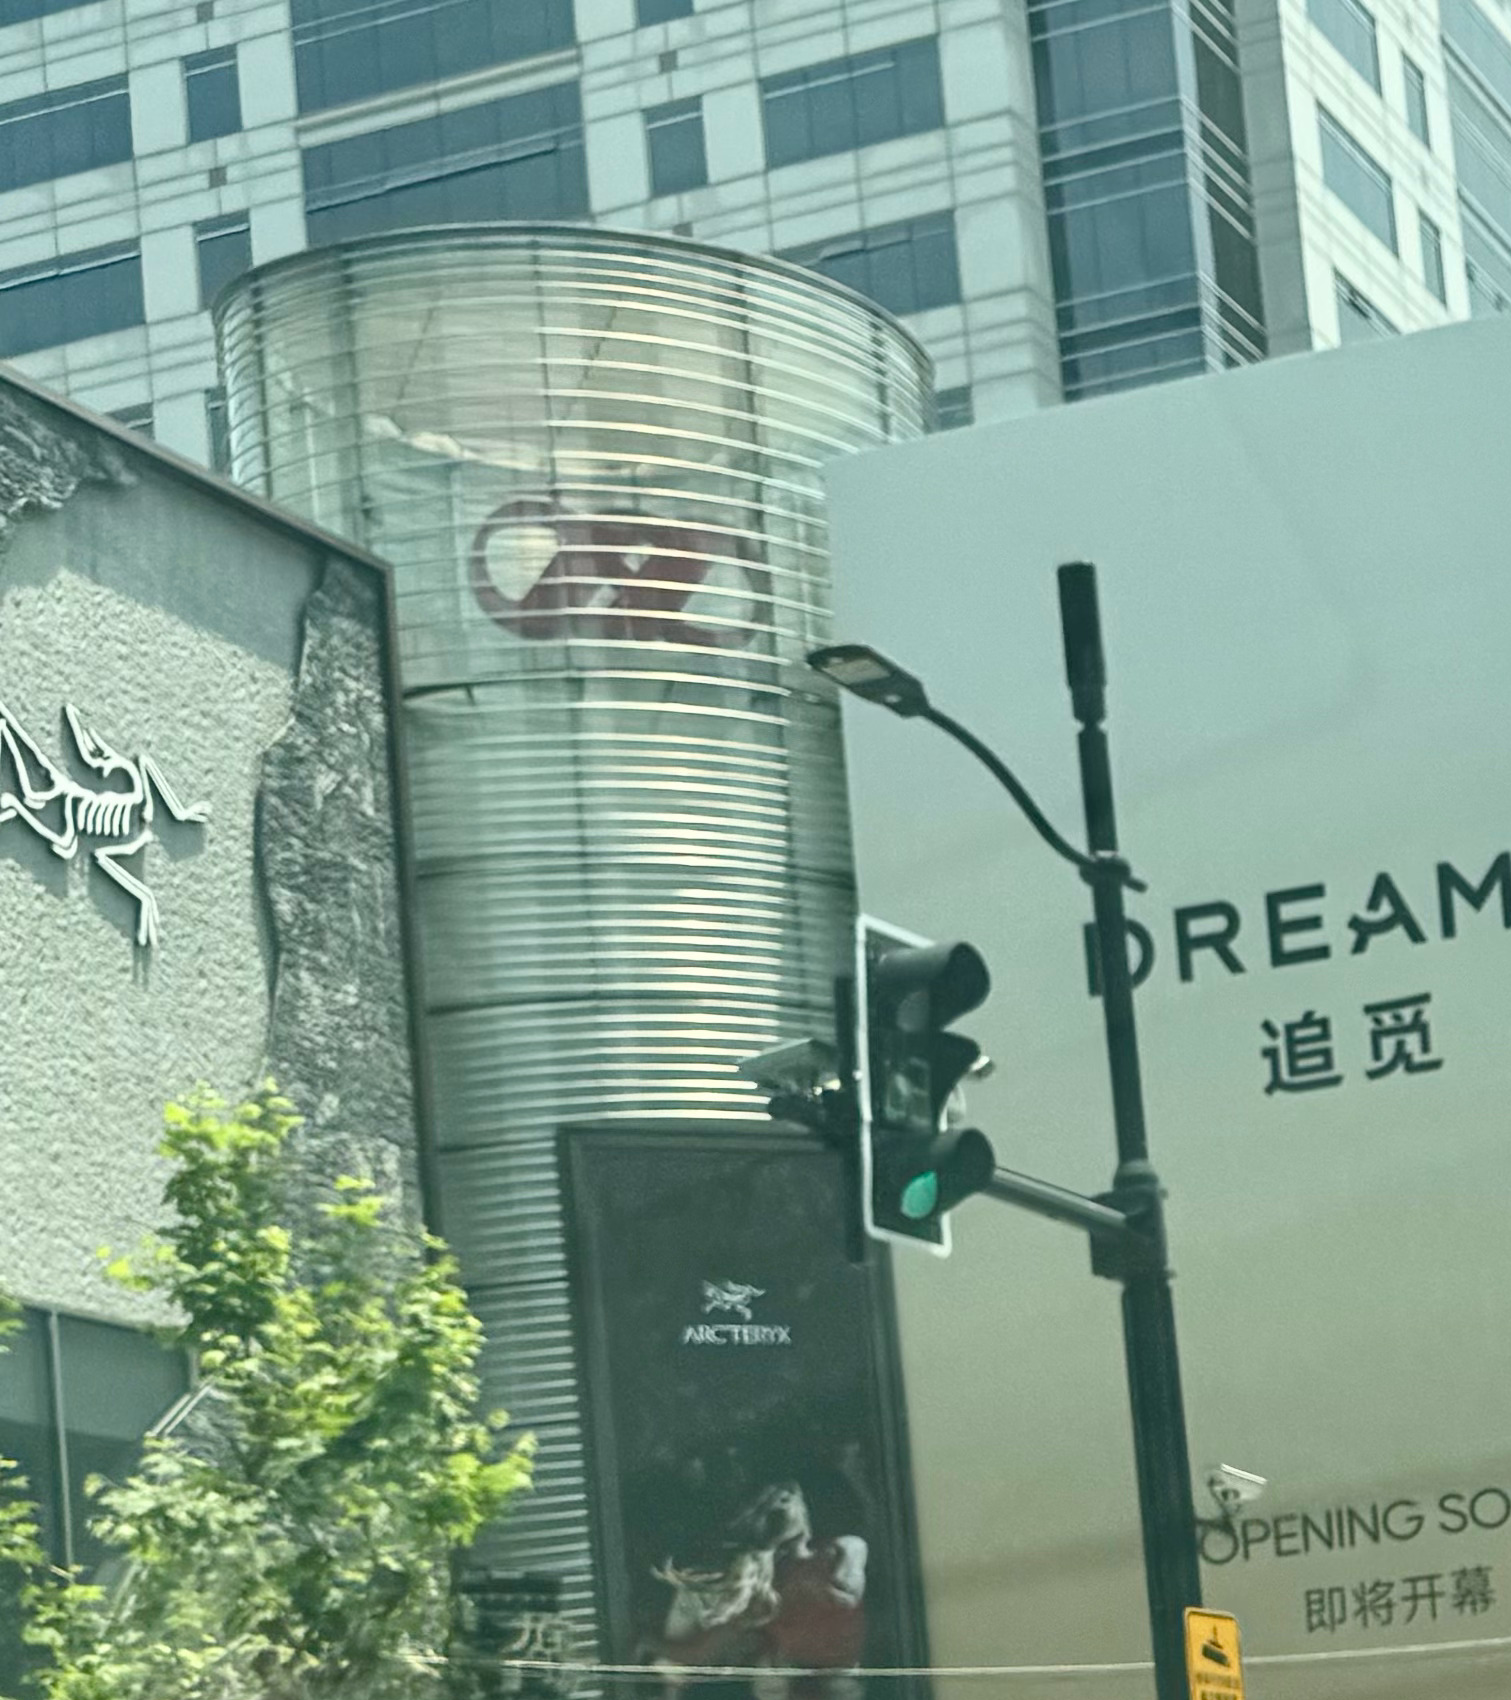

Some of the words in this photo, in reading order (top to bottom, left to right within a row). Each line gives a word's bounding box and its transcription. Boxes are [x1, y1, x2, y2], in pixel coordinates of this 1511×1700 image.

[1260, 992, 1444, 1096] 追觅
[1199, 1498, 1425, 1565] OPENING
[1304, 1564, 1498, 1635] 即将开幕
